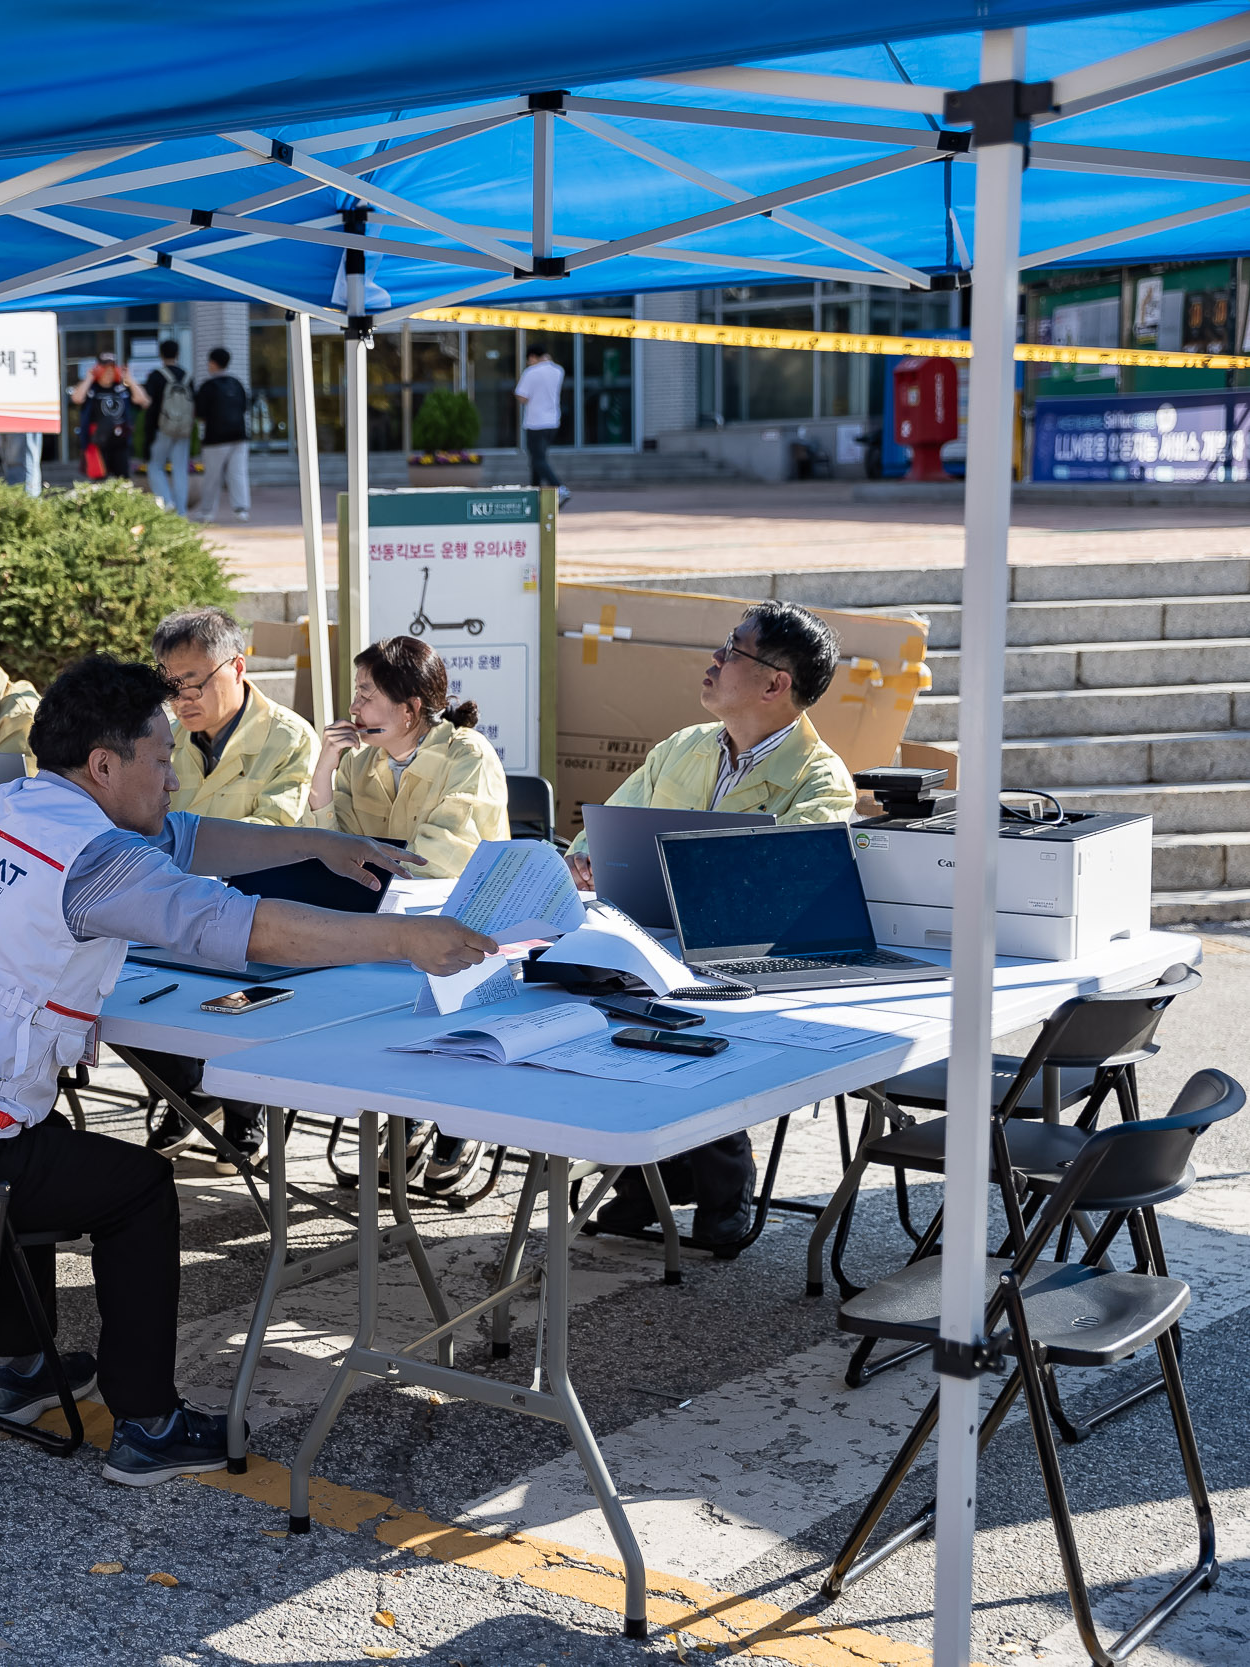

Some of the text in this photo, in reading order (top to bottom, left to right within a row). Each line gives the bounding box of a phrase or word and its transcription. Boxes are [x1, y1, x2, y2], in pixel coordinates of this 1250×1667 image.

[472, 503, 493, 516] KU
[369, 539, 527, 561] 전동킥보드 운행 유의사항
[478, 655, 502, 670] 운행
